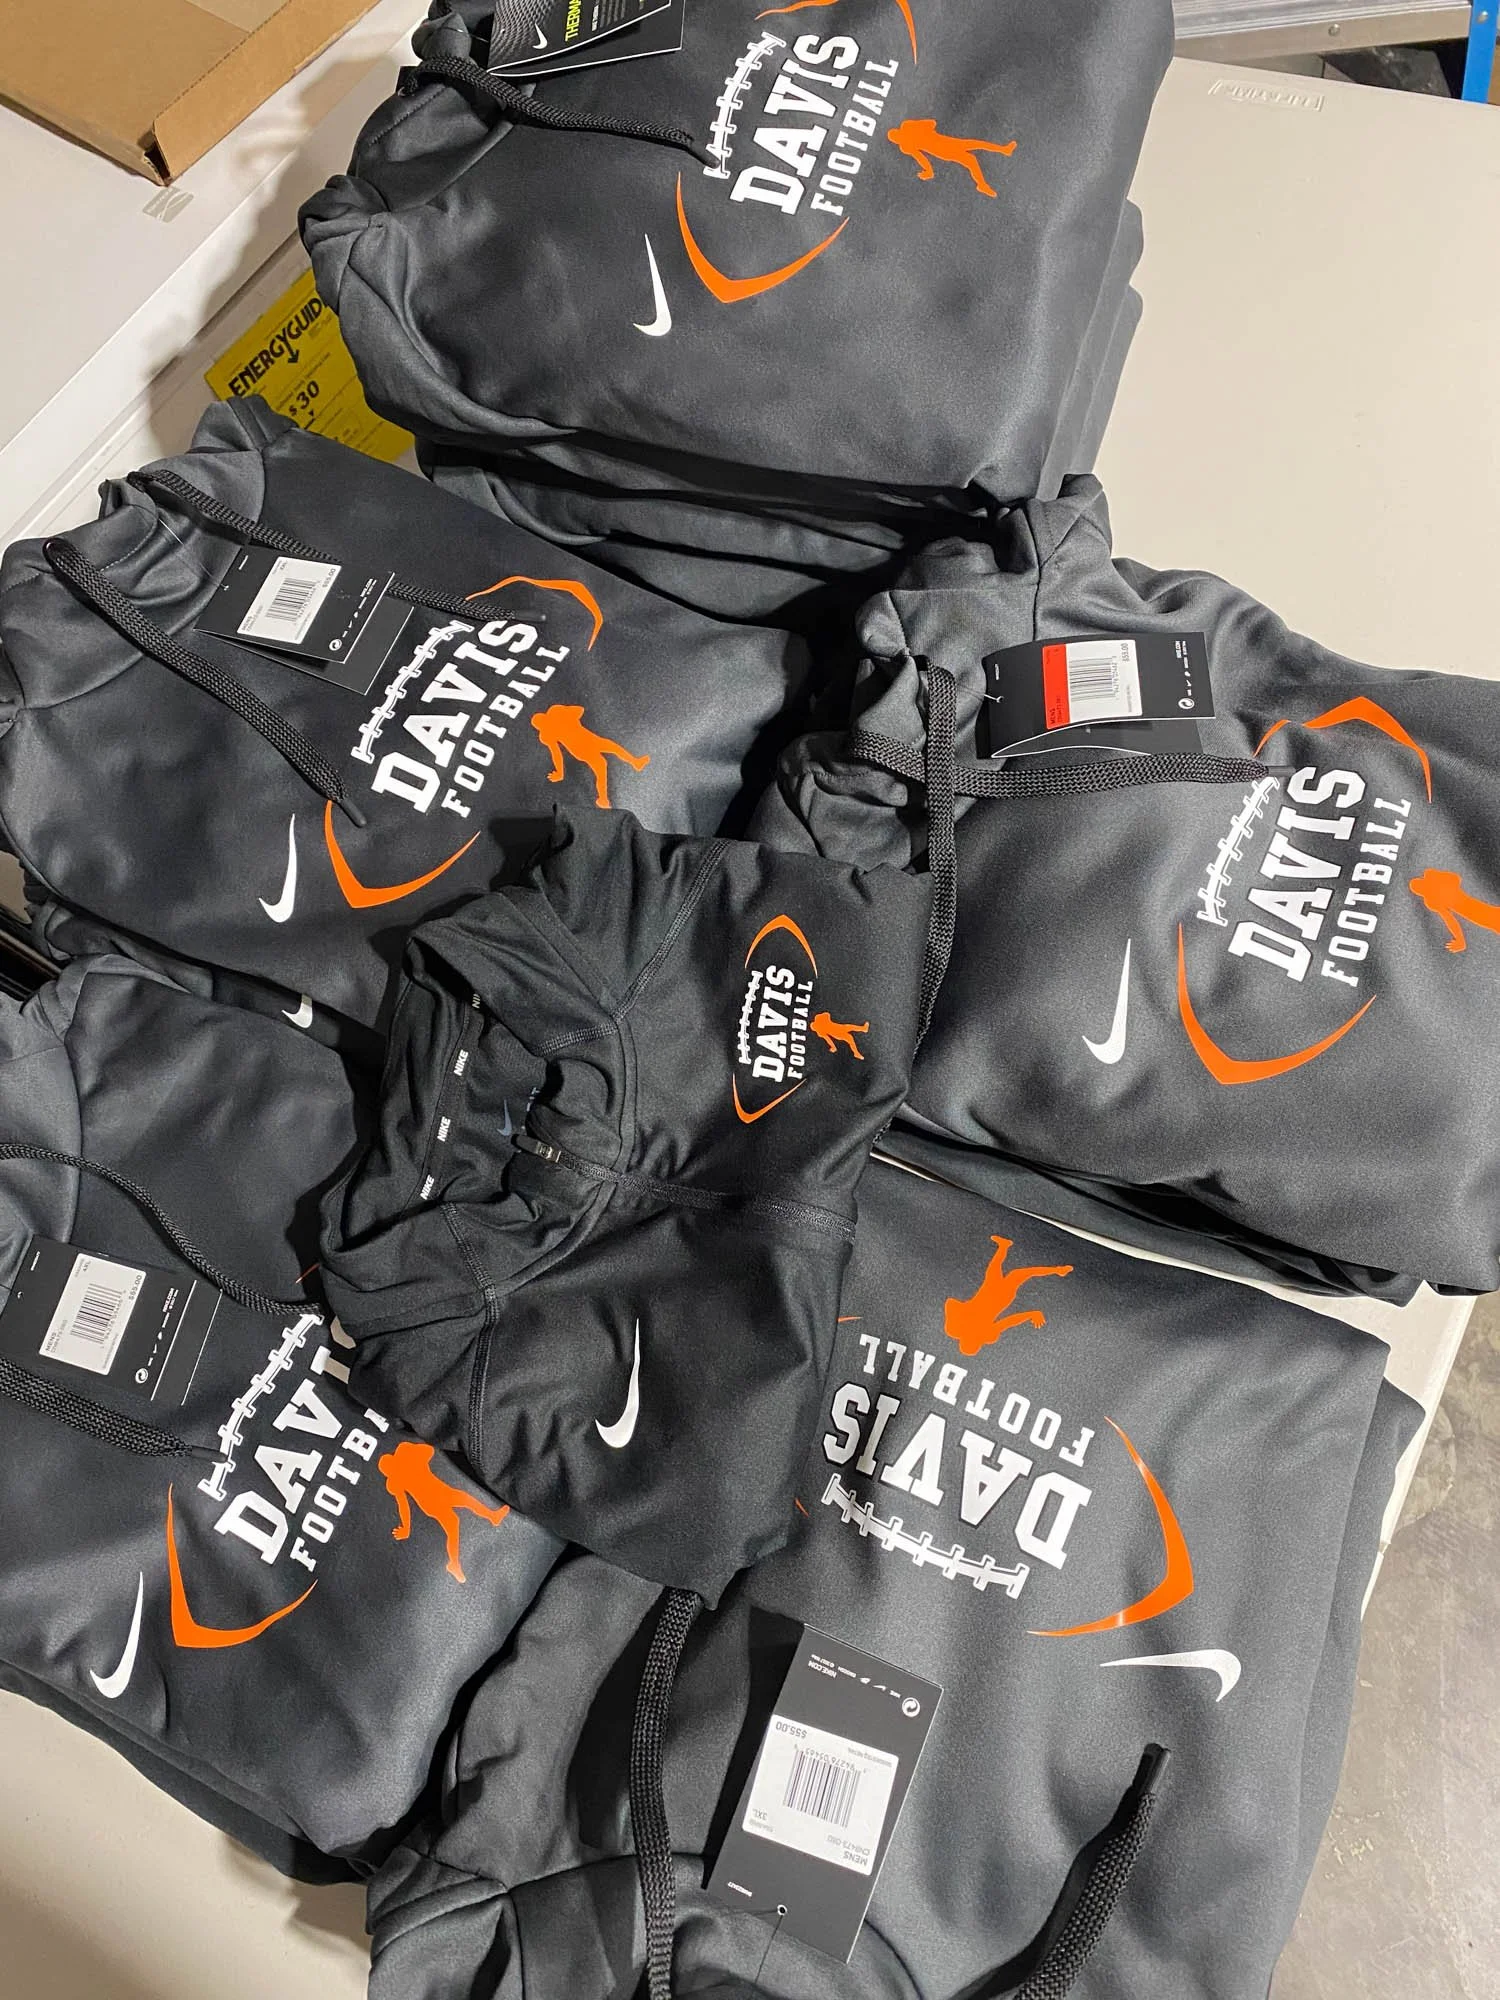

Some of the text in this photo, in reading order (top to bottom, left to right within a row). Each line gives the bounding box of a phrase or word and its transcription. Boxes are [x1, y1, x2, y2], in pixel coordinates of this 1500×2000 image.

[730, 34, 861, 216] DAVIS
[810, 58, 899, 217] FOOTBALL
[228, 297, 329, 397] ENERGYGUID
[371, 620, 538, 813] DAVIS
[441, 645, 570, 818] FOOTBALL
[1228, 766, 1366, 982] DAVIS
[1321, 797, 1412, 987] FOOTBALL
[472, 994, 481, 1009] NI
[752, 965, 795, 1083] DAVIS
[788, 980, 813, 1079] FOOTBALL
[453, 1050, 469, 1076] NIKE
[437, 1116, 451, 1142] NIKE
[420, 1174, 435, 1200] NIKE
[46, 1332, 57, 1351] MENS
[214, 1316, 356, 1564] DAVI
[859, 1333, 1095, 1467] FOOTBALL
[290, 1408, 389, 1572] FOOTB
[823, 1383, 1092, 1570] DAVIS
[808, 1661, 837, 1678] NIKE.COM
[776, 1720, 807, 1738] $55.00
[753, 1808, 768, 1821] 3XL
[843, 1852, 868, 1866] MENS
